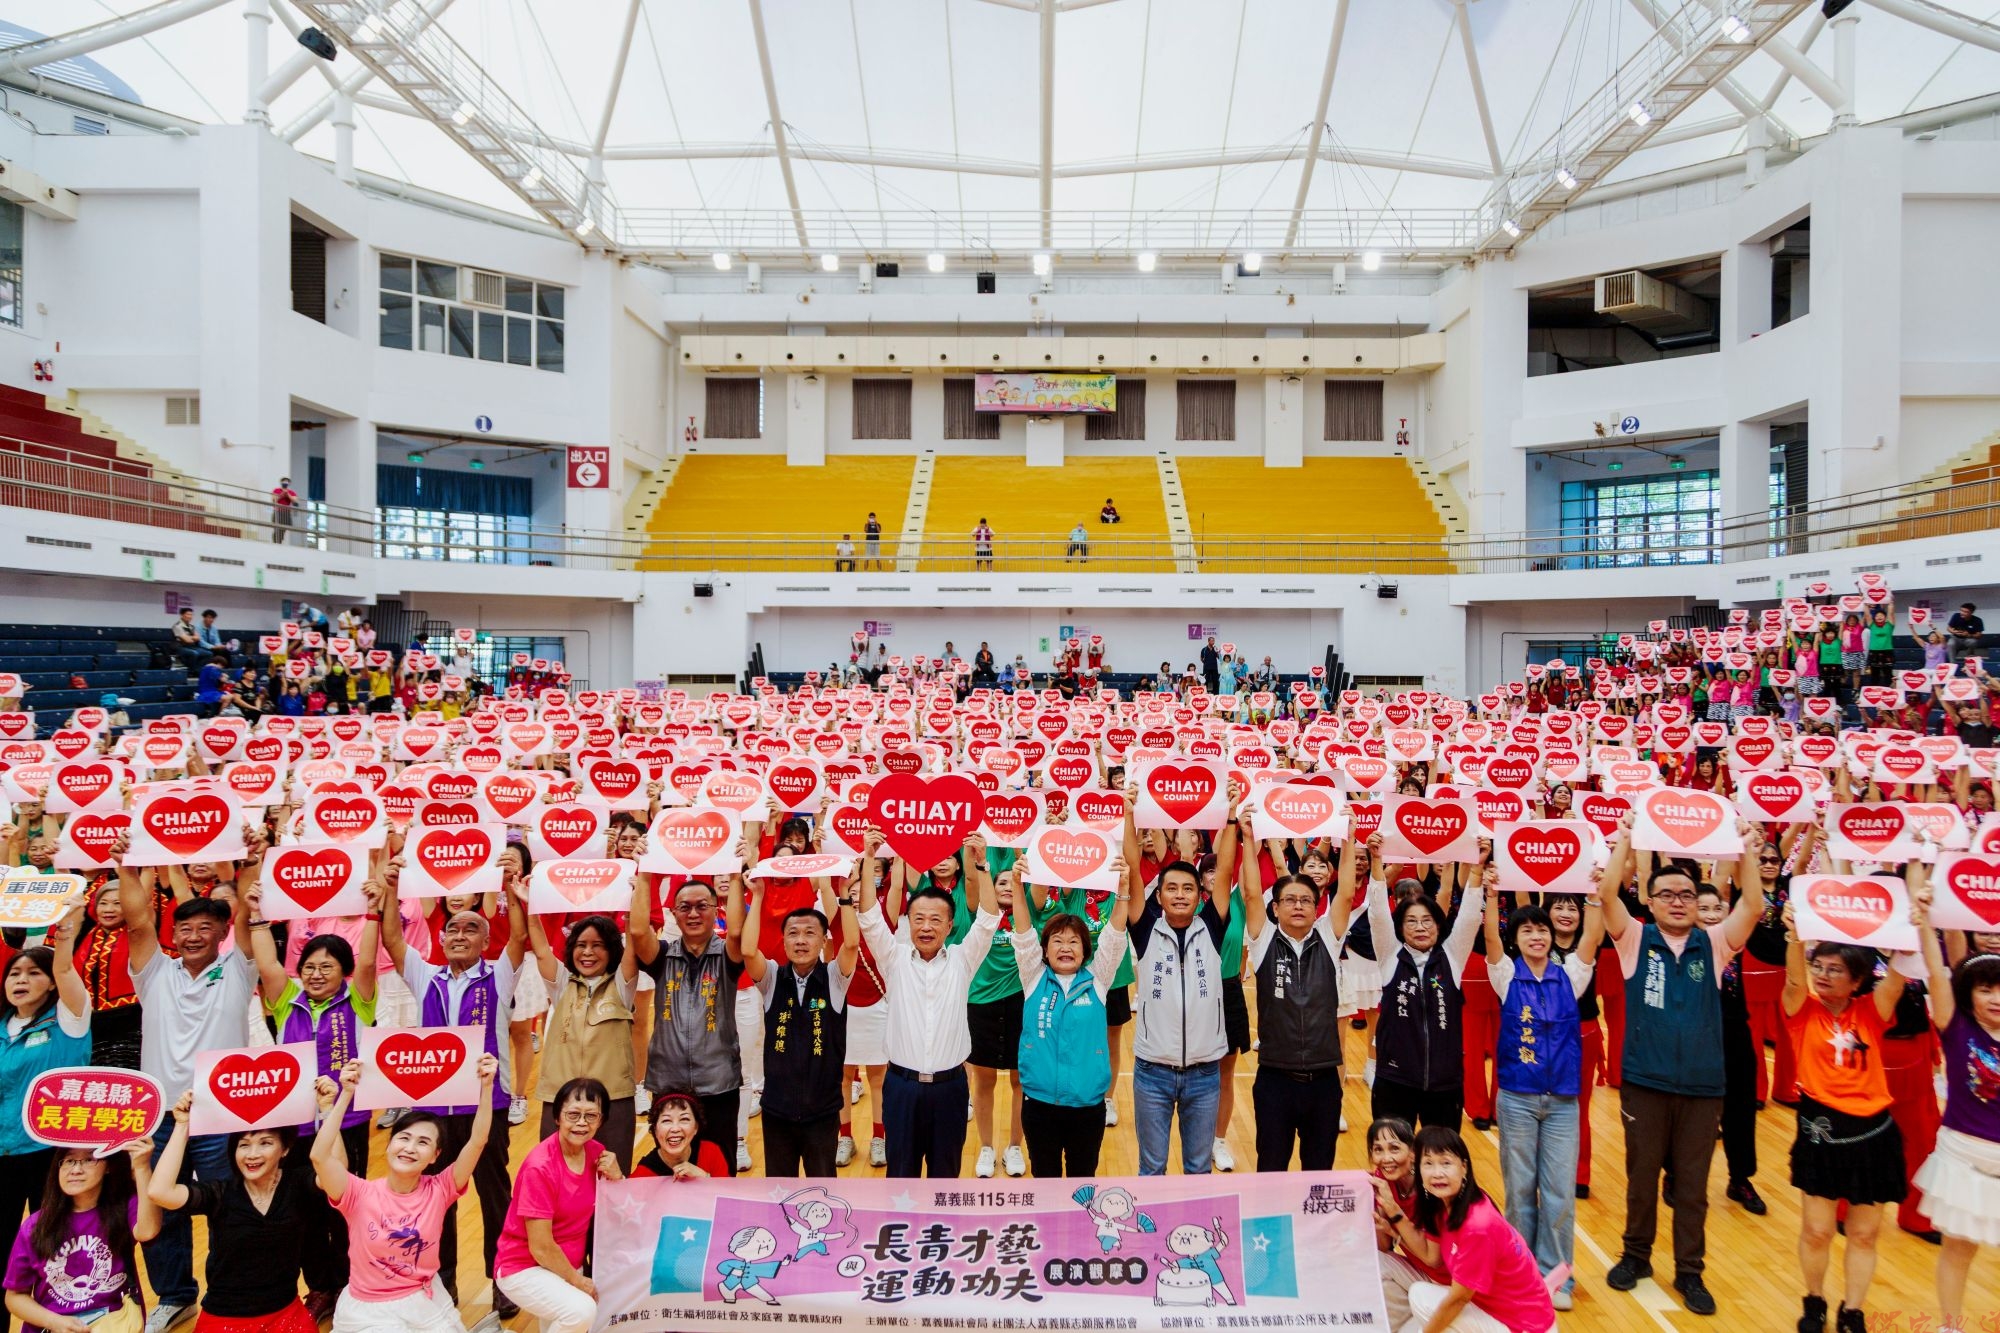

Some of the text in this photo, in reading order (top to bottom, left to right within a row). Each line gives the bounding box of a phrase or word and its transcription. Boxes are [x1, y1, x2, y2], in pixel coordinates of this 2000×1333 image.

[481, 416, 488, 431] 1
[1625, 417, 1636, 433] 2
[570, 450, 607, 463] 出入口
[147, 743, 179, 751] CHIAYI
[249, 744, 280, 755] CHIAYI
[988, 757, 1018, 765] CHIAYI
[1885, 756, 1922, 765] CHIAYI
[232, 773, 272, 782] CHIAYI
[305, 770, 342, 778] CHIAYI
[595, 772, 636, 782] CHIAYI
[1492, 768, 1528, 776] CHIAYI
[62, 775, 108, 785] CHIAYI
[773, 776, 812, 786] CHIAYI
[490, 786, 531, 796] CHIAYI
[712, 785, 756, 795] CHIAYI
[1155, 781, 1209, 793] CHIAYI
[1753, 785, 1799, 795] CHIAYI
[880, 799, 972, 821] CHIAYI
[986, 807, 1032, 817] CHIAYI
[1081, 803, 1123, 815] CHIAYI
[1271, 801, 1327, 813] CHIAYI
[1477, 802, 1518, 812] CHIAYI
[1654, 804, 1717, 819] CHIAYI
[151, 810, 221, 826] CHIAYI
[320, 810, 371, 820] CHIAYI
[427, 814, 473, 823] CHIAYI
[544, 820, 591, 831] CHIAYI
[1403, 815, 1460, 829] CHIAYI
[1664, 818, 1706, 827] COUNTY
[1845, 818, 1899, 828] CHIAYI
[163, 825, 210, 835] COUNTY
[550, 831, 582, 839] COUNTY
[665, 827, 722, 838] CHIAYI
[894, 823, 955, 836] COUNTY
[674, 840, 712, 848] COUNTY
[1515, 842, 1573, 855] CHIAYI
[424, 844, 484, 858] CHIAYI
[1045, 843, 1100, 858] CHIAYI
[434, 859, 473, 867] COUNTY
[778, 858, 834, 867] CHIAYI
[1054, 856, 1089, 866] COUNTY
[281, 864, 344, 880] CHIAYI
[555, 867, 613, 877] CHIAYI
[292, 880, 332, 888] COUNTY
[562, 877, 601, 885] COUNTY
[5, 882, 71, 893] 重陽節
[1815, 895, 1886, 911] CHIAYI
[385, 1049, 457, 1065] CHIAYI
[396, 1065, 443, 1075] COUNTY
[218, 1068, 291, 1088] CHIAYI
[57, 1079, 132, 1106] 嘉義縣
[229, 1086, 278, 1098] COUNTY
[37, 1105, 147, 1133] 長青學苑
[934, 1191, 1035, 1207] 嘉義縣115年度
[864, 1223, 1041, 1265] 長青才藝
[1049, 1264, 1143, 1279] 展演觀摩會
[861, 1267, 1044, 1303] 運動功夫
